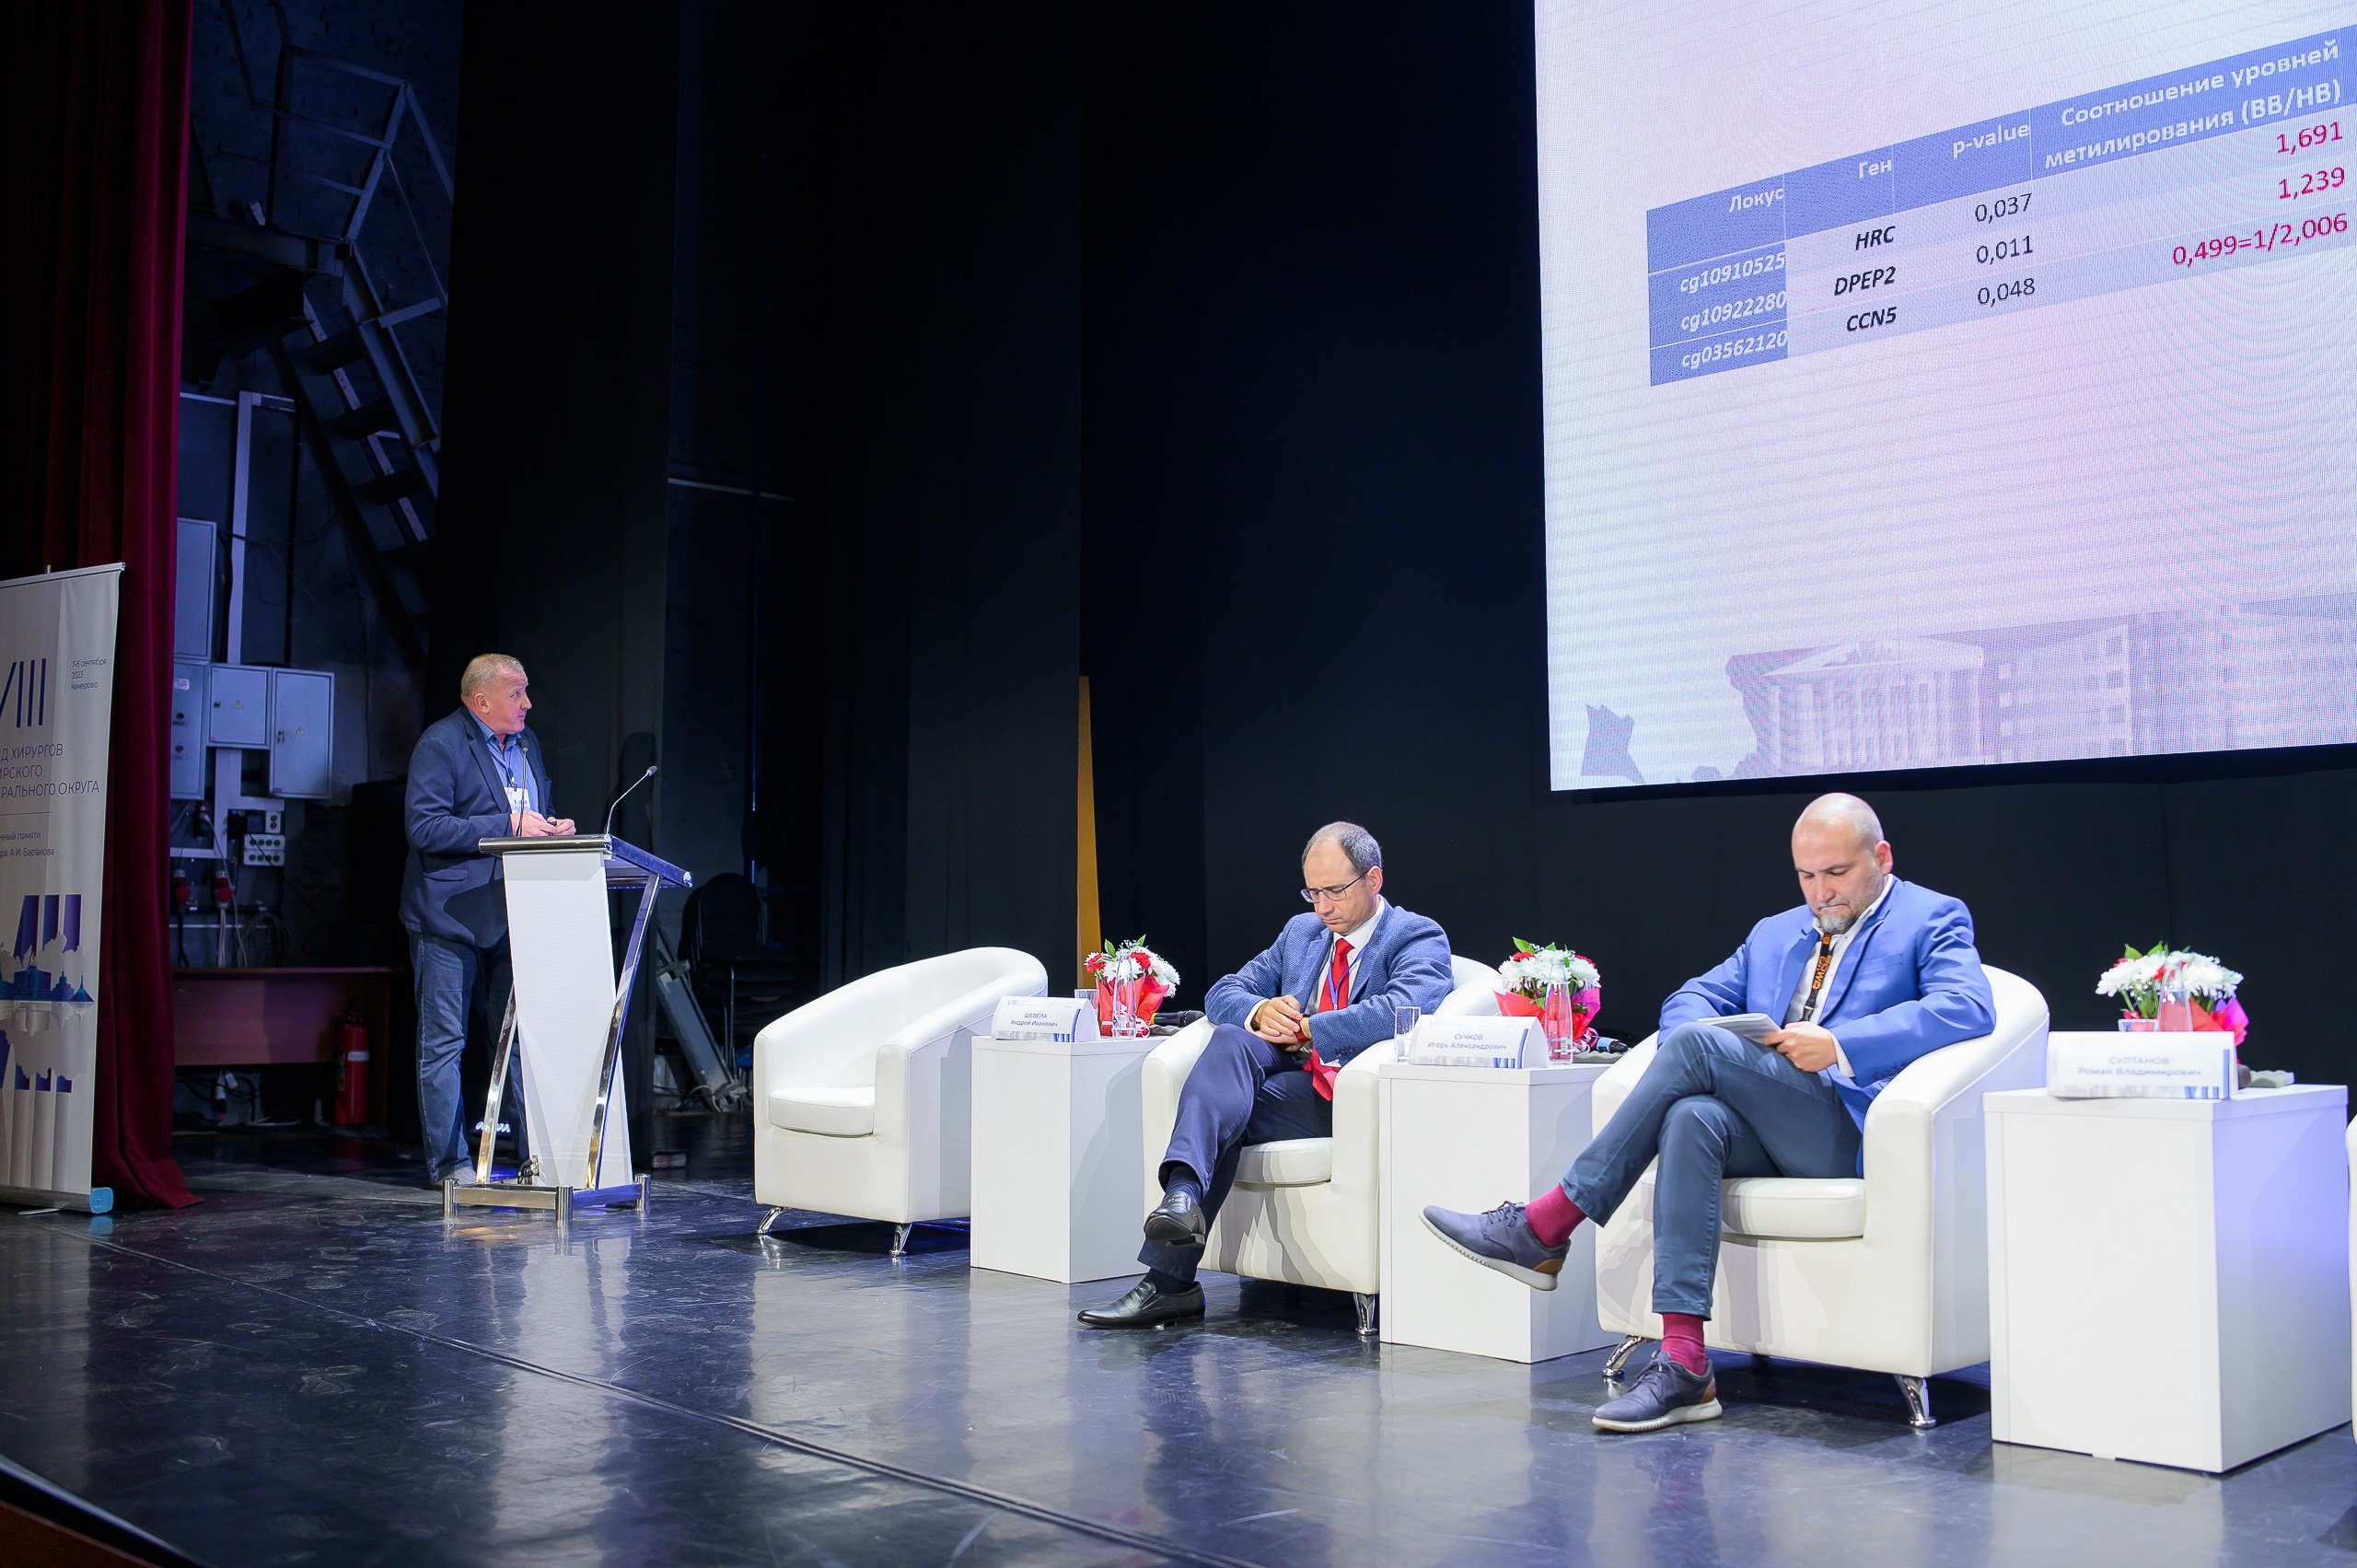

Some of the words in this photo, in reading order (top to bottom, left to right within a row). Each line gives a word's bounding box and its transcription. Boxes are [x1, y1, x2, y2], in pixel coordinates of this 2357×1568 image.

[2061, 74, 2225, 126] Соотношение
[2231, 38, 2341, 88] уровней
[2045, 110, 2235, 169] метилирования
[2241, 79, 2342, 126] (ВВ/НВ)
[2276, 122, 2343, 155] 1,691
[1952, 124, 2029, 159] p-value
[1859, 158, 1892, 180] Ген
[2278, 167, 2345, 200] 1,239
[1728, 187, 1784, 214] Локус
[1974, 192, 2033, 225] 0,037
[1855, 225, 1897, 250] HRC
[1976, 235, 2034, 265] 0,011
[2172, 213, 2348, 268] 0,499=1/2,006
[1680, 251, 1787, 295] cg10910525
[1833, 265, 1897, 296] DPEP2
[1977, 277, 2036, 308] 0,048
[1680, 290, 1788, 333] cg10922280
[1846, 307, 1898, 332] CCN5
[1681, 330, 1788, 369] cg03562120
[71, 681, 99, 691] Кемерово
[10, 743, 64, 761] ХИРУРГОВ
[0, 783, 56, 799] РАЛЬНОГО
[58, 780, 100, 796] ОКРУГА
[17, 831, 41, 840] памяти
[23, 847, 54, 858] Баранова
[1428, 1041, 1449, 1050] Игорь
[1450, 1042, 1506, 1051] Александрович
